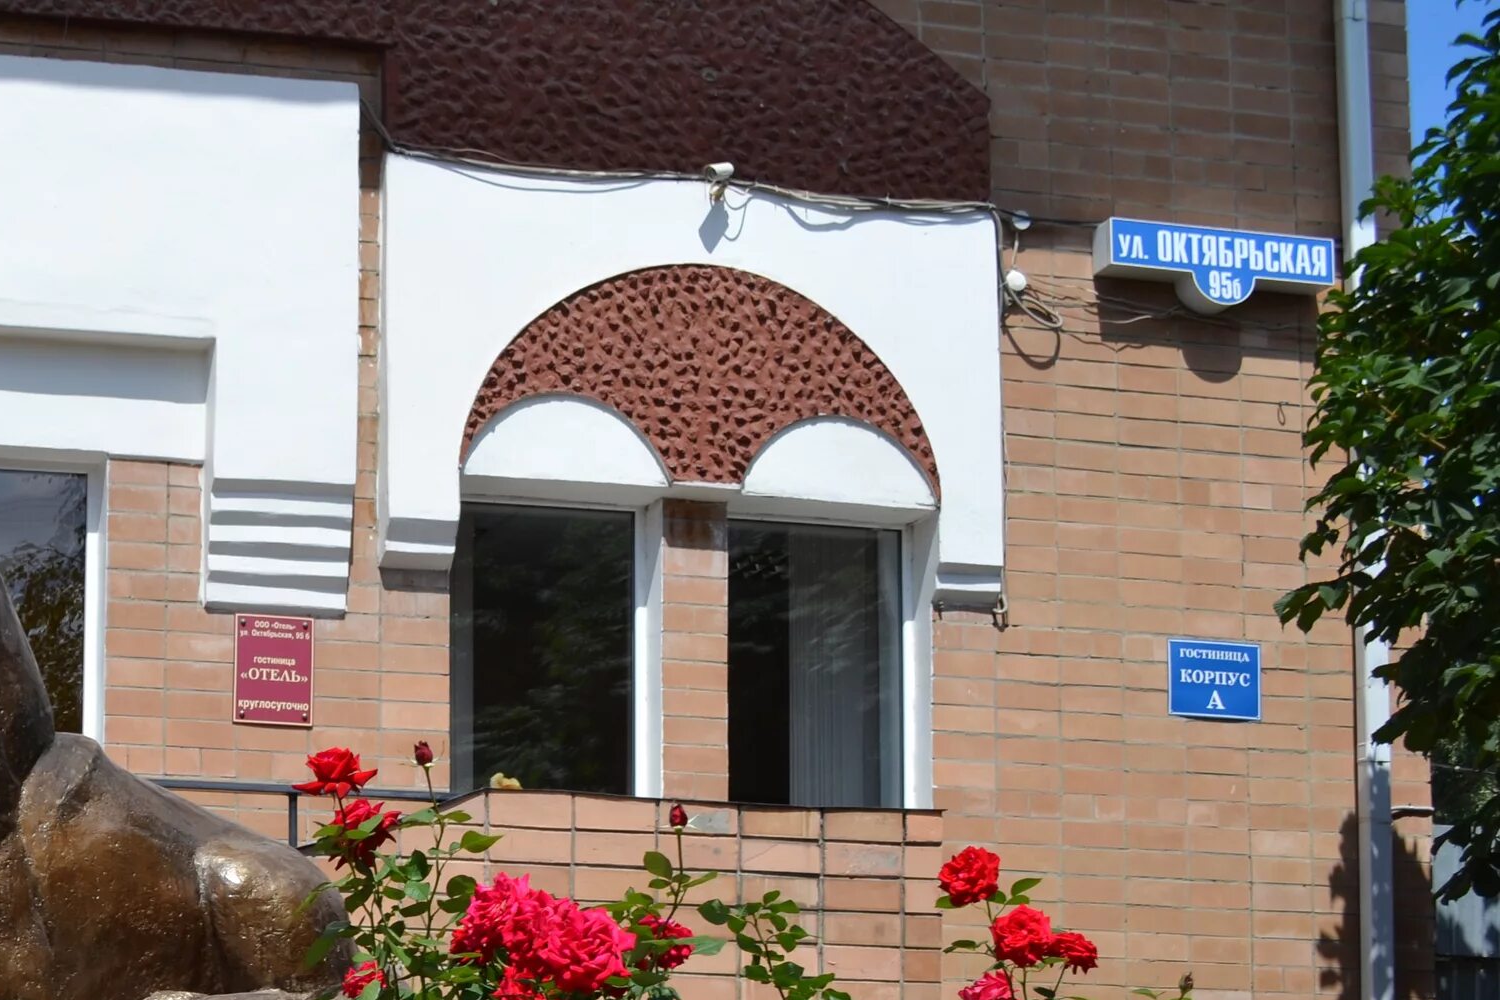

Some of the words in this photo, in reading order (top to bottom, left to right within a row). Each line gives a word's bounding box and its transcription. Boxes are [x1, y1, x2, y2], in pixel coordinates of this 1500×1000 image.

[1117, 234, 1149, 260] ул.
[1156, 229, 1328, 277] ОКТЯБРЬСКАЯ
[1208, 270, 1242, 300] 95б
[254, 620, 270, 629] ООО
[253, 656, 296, 667] гостиница
[1179, 648, 1250, 663] ГОСТИНИЦА
[240, 667, 308, 683] «ОТЕЛЬ»
[1180, 668, 1250, 687] КОРПУС
[238, 699, 309, 712] круглосуточно
[1206, 690, 1226, 710] А
